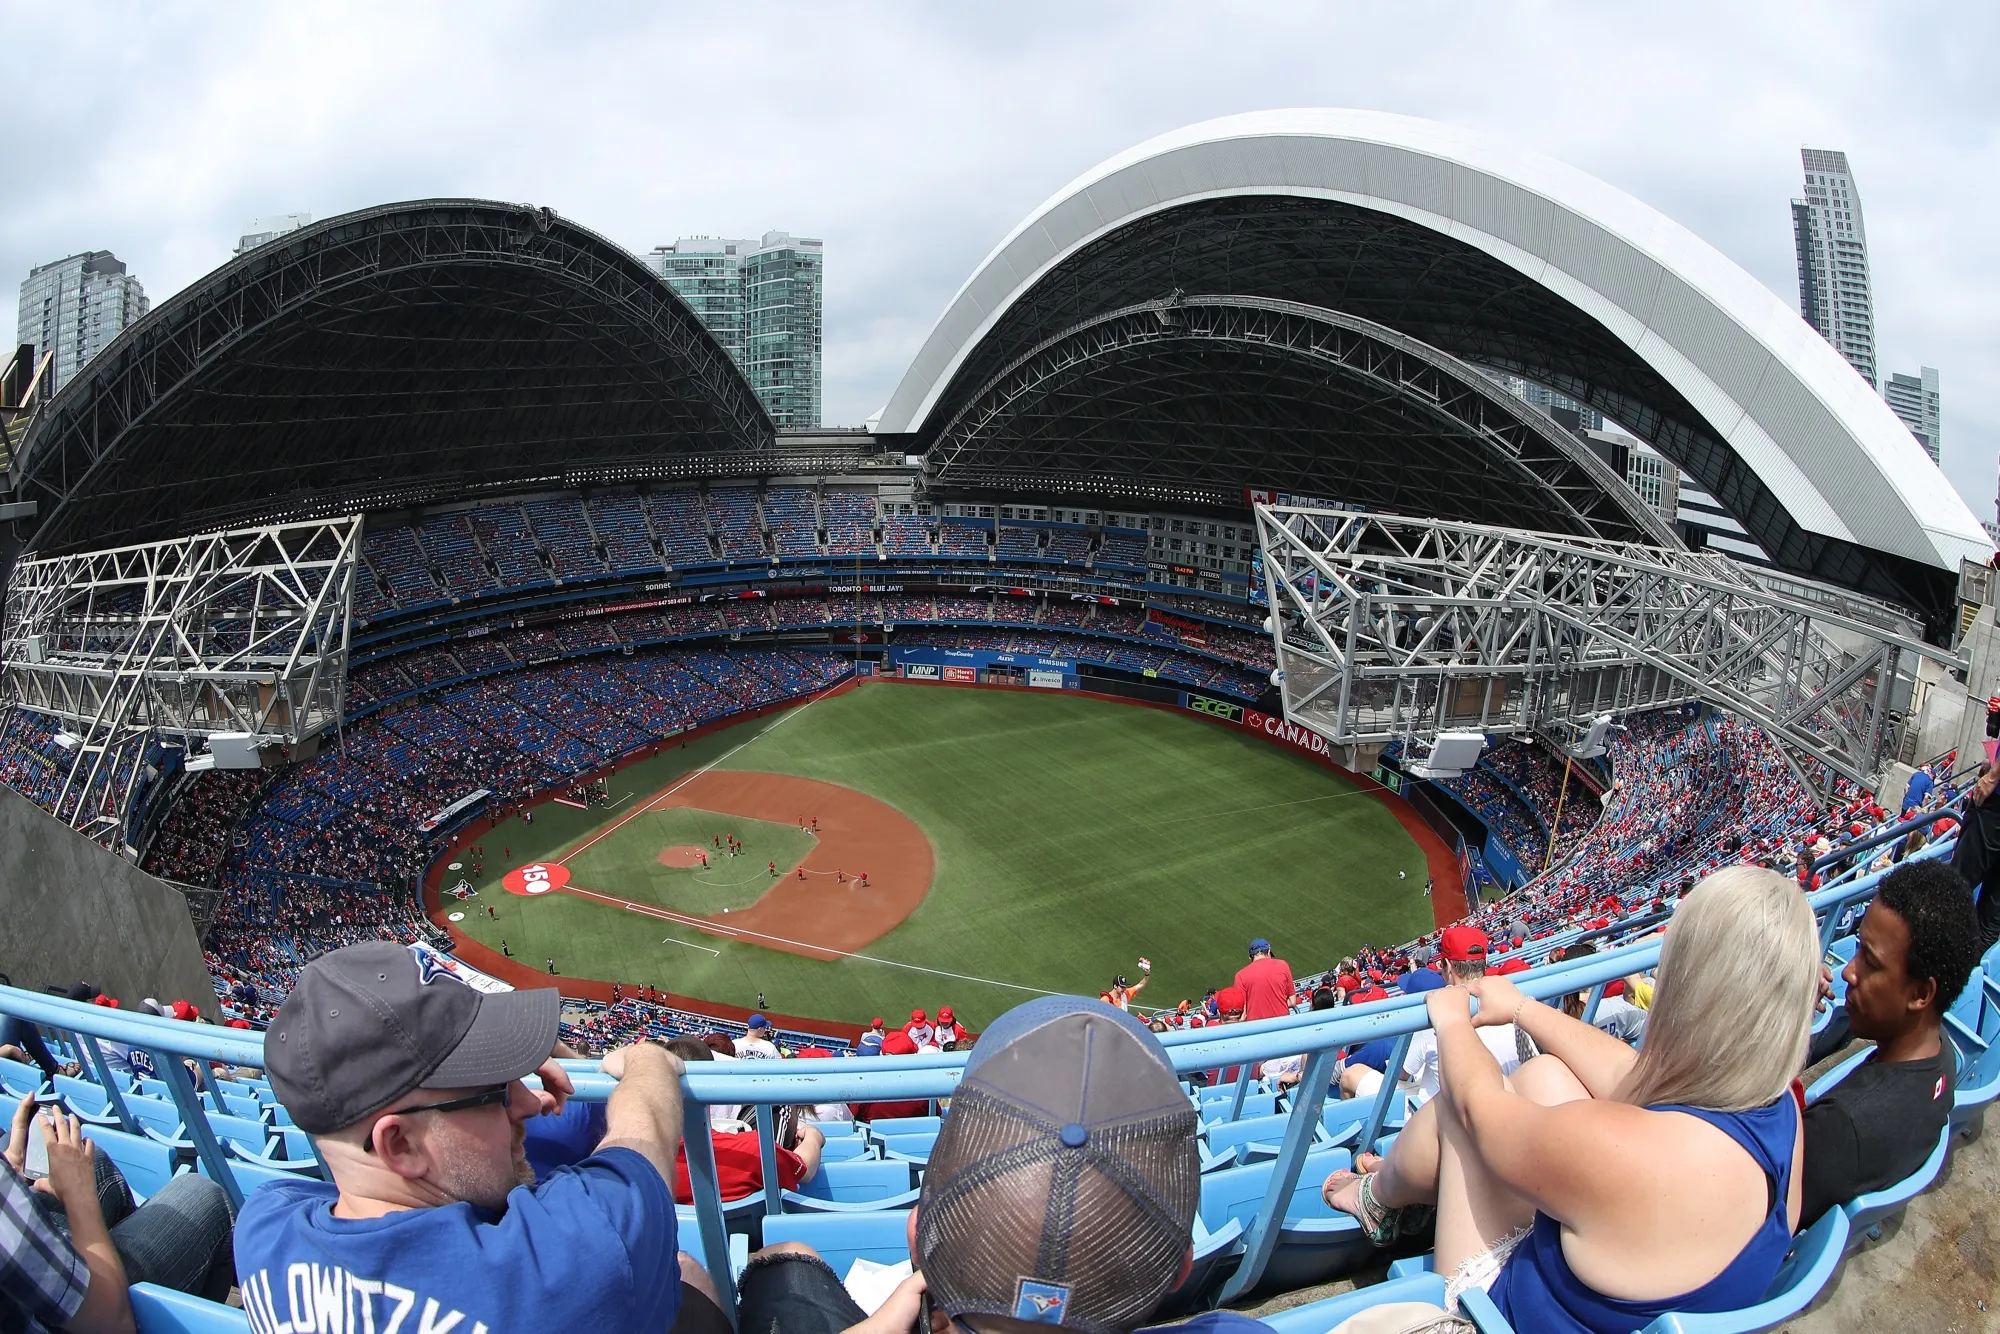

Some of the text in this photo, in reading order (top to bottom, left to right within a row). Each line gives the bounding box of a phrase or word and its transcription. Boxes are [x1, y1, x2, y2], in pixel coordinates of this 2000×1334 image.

[1148, 562, 1168, 570] CITIZEN
[1200, 571, 1220, 579] CITIZEN
[645, 582, 672, 591] sonnet
[828, 585, 862, 593] TORONTO
[1038, 658, 1068, 668] SAMSUNG
[911, 665, 936, 675] MNP
[1040, 676, 1061, 684] invesco
[1191, 696, 1240, 719] acer
[1264, 717, 1332, 758] CANADA
